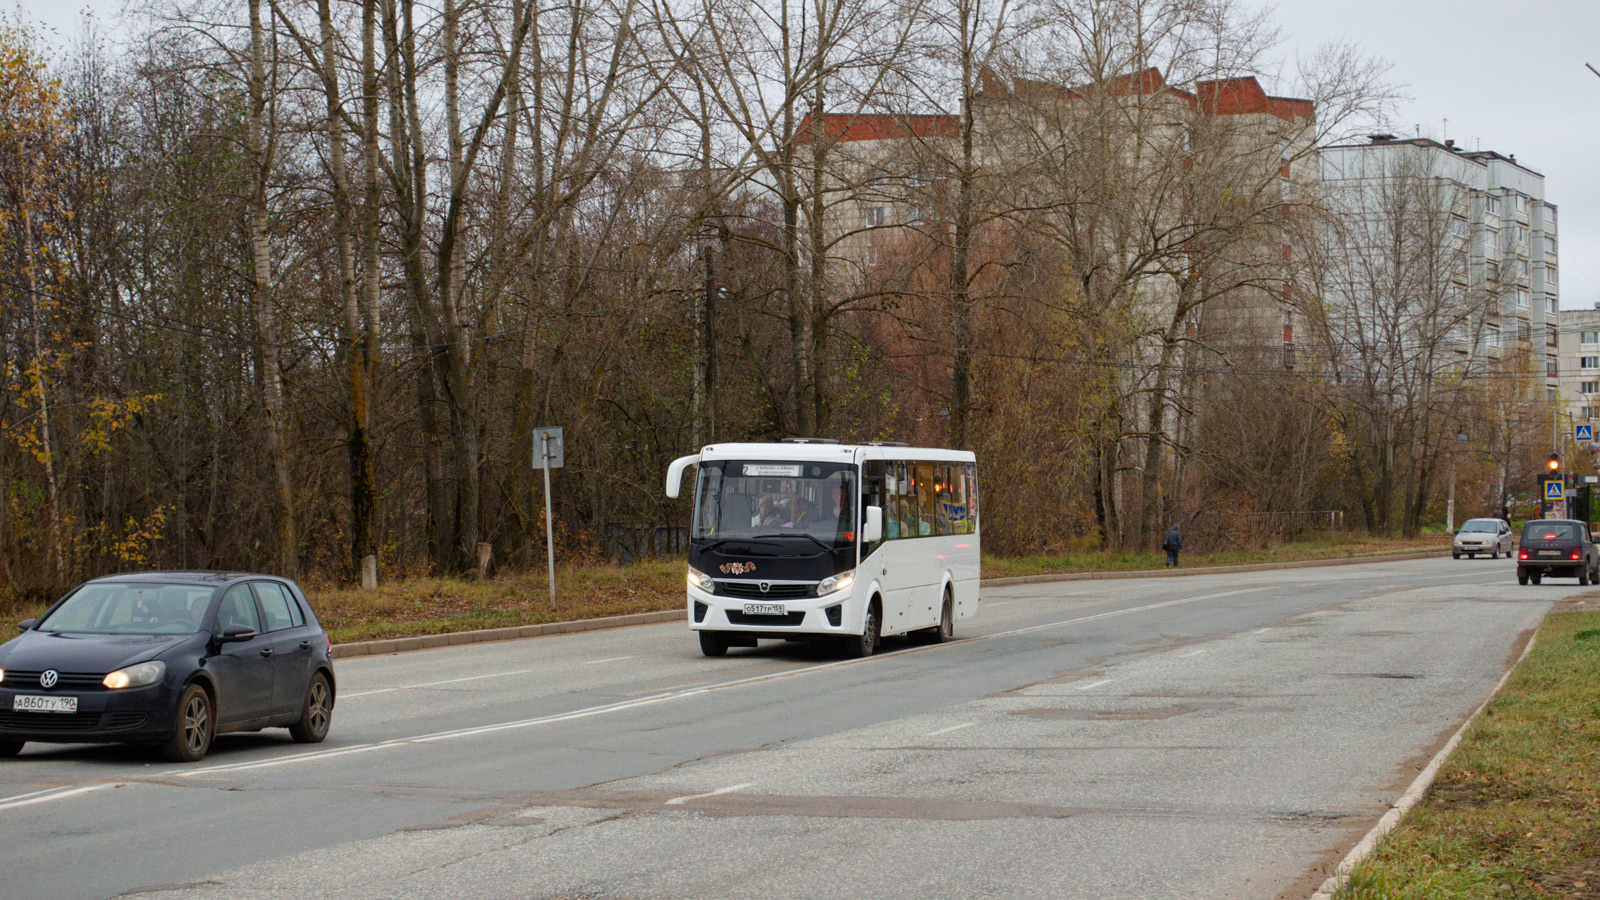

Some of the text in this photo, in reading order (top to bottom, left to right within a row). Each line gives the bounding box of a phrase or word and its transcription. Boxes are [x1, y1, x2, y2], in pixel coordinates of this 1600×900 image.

[743, 465, 749, 476] 2
[16, 697, 75, 709] А860ТУ 190
